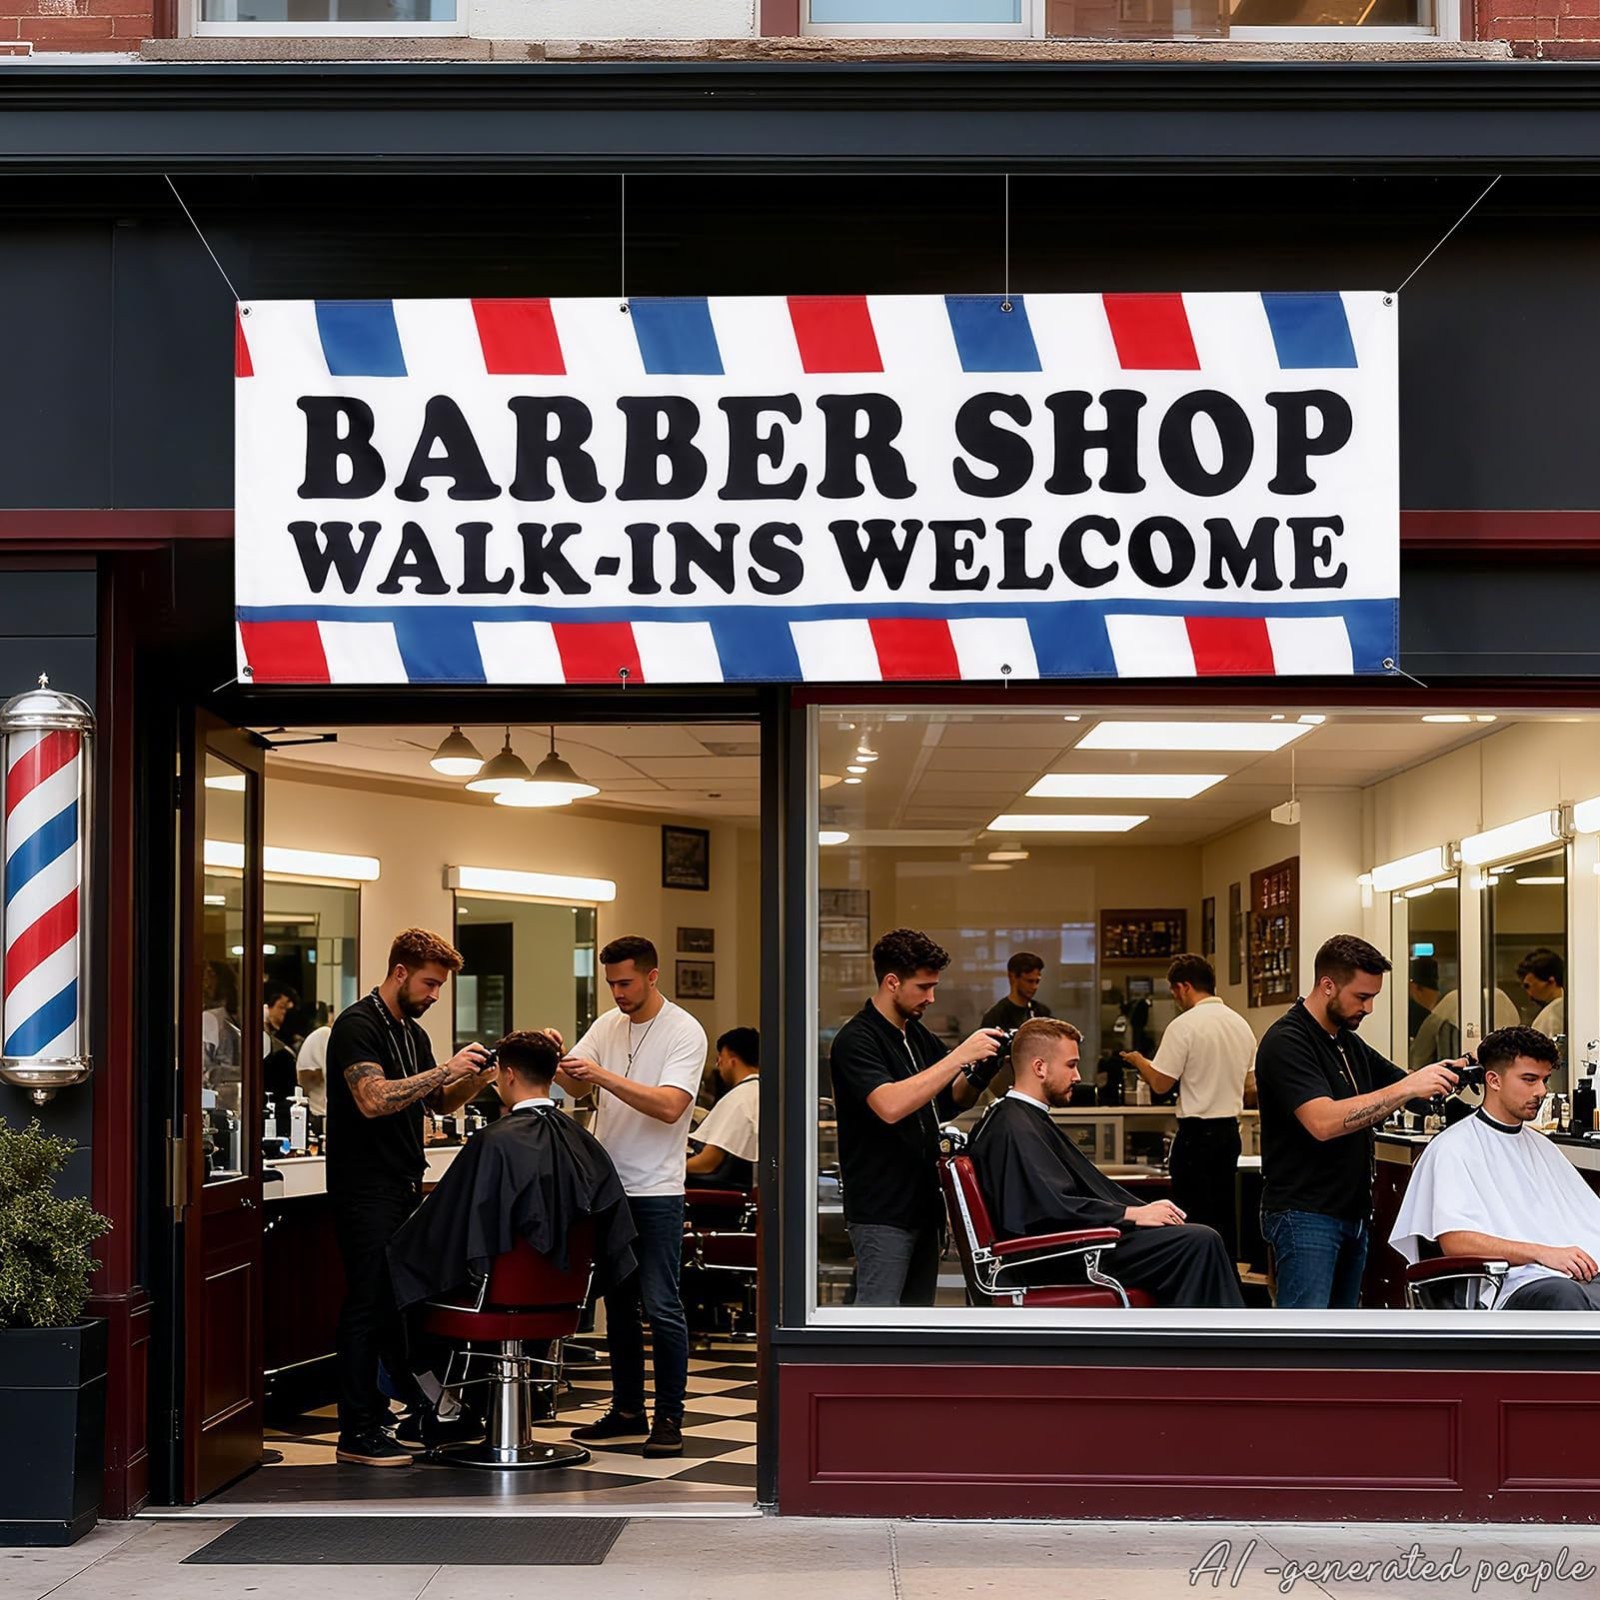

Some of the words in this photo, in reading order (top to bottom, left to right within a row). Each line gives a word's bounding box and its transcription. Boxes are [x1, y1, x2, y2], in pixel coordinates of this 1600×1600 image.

[297, 393, 916, 503] BARBER
[953, 389, 1352, 498] SHOP
[288, 521, 803, 595] WALK-INS
[828, 515, 1347, 591] WELCOME
